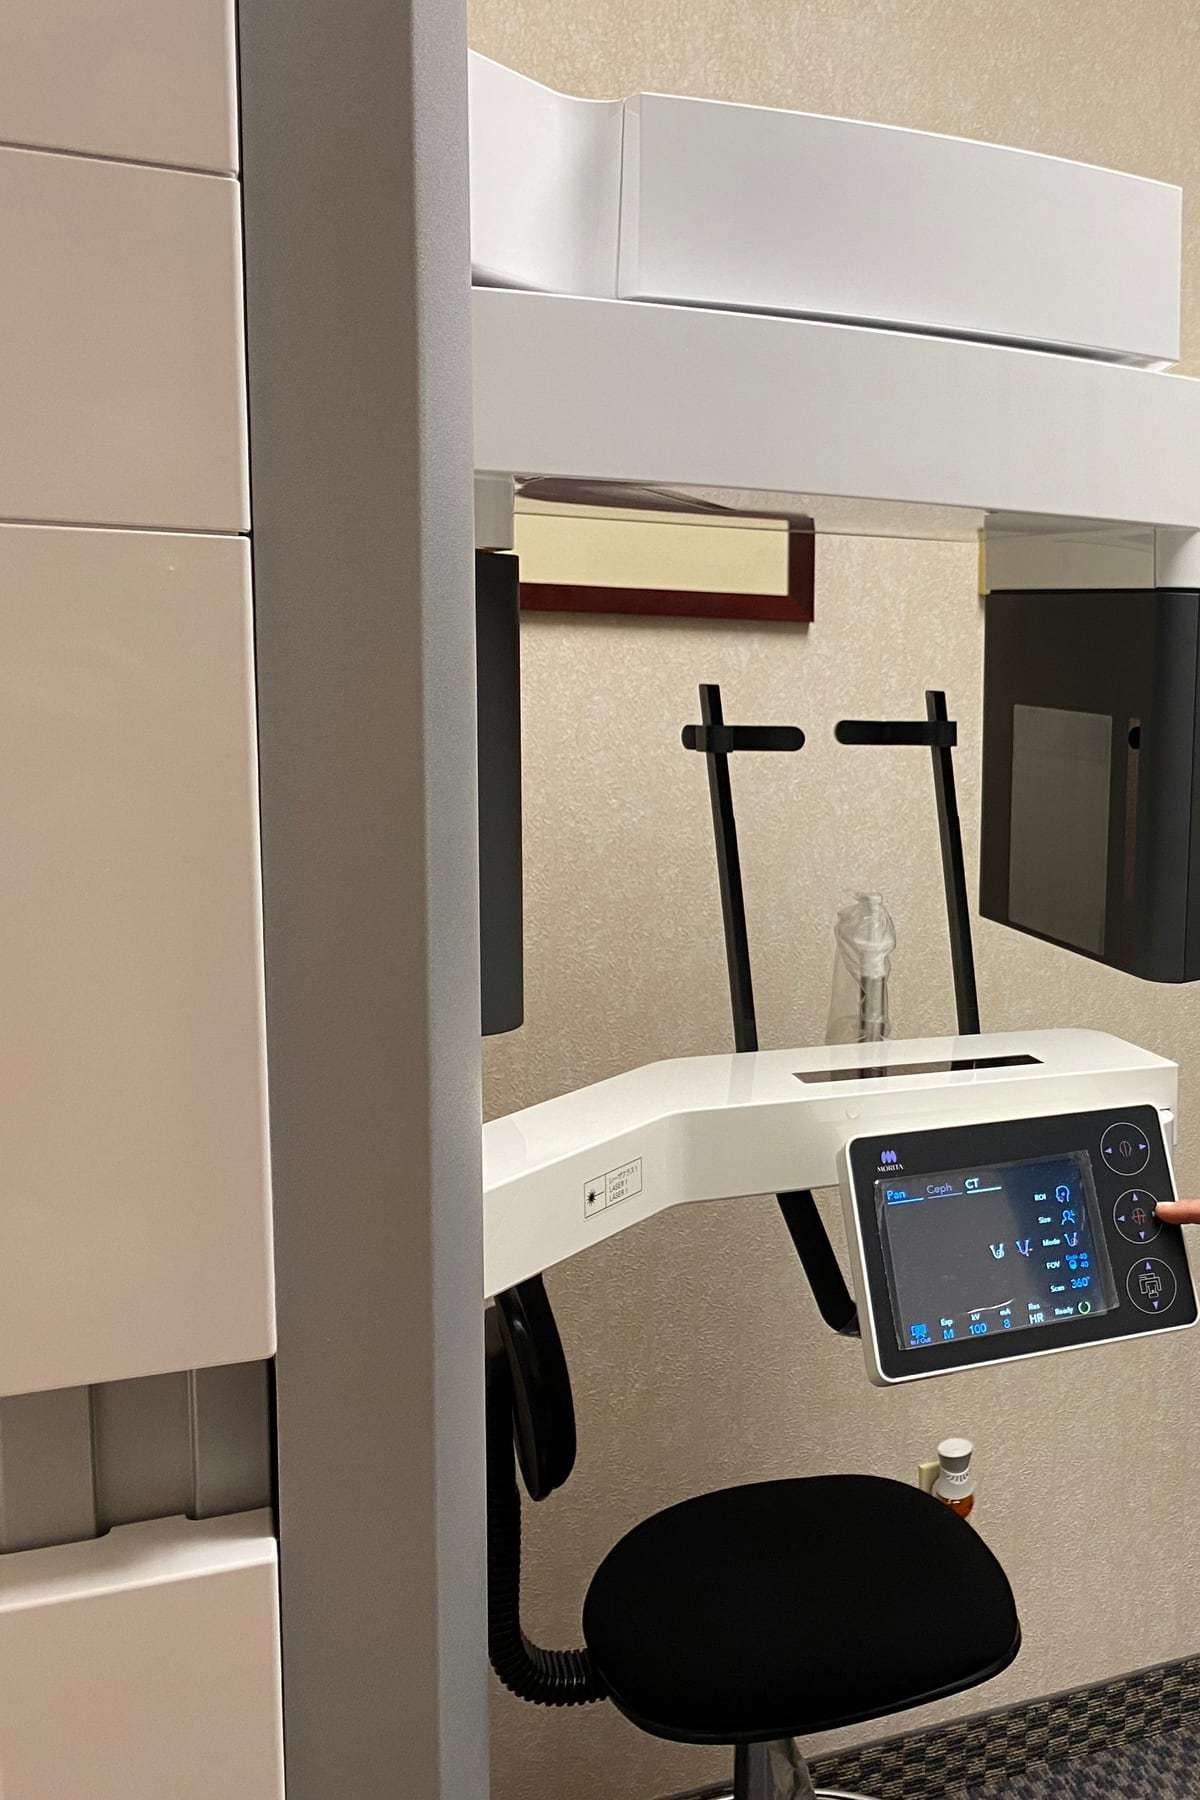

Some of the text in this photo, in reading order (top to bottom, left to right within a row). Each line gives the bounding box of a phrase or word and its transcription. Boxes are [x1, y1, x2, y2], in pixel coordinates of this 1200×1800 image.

[877, 1163, 904, 1173] MORITA
[886, 1178, 980, 1200] Pan Ceph CT
[1046, 1260, 1060, 1269] FOV
[1003, 1319, 1011, 1328] 8
[1029, 1312, 1044, 1324] HR
[943, 1328, 954, 1340] M
[968, 1323, 987, 1335] 100
